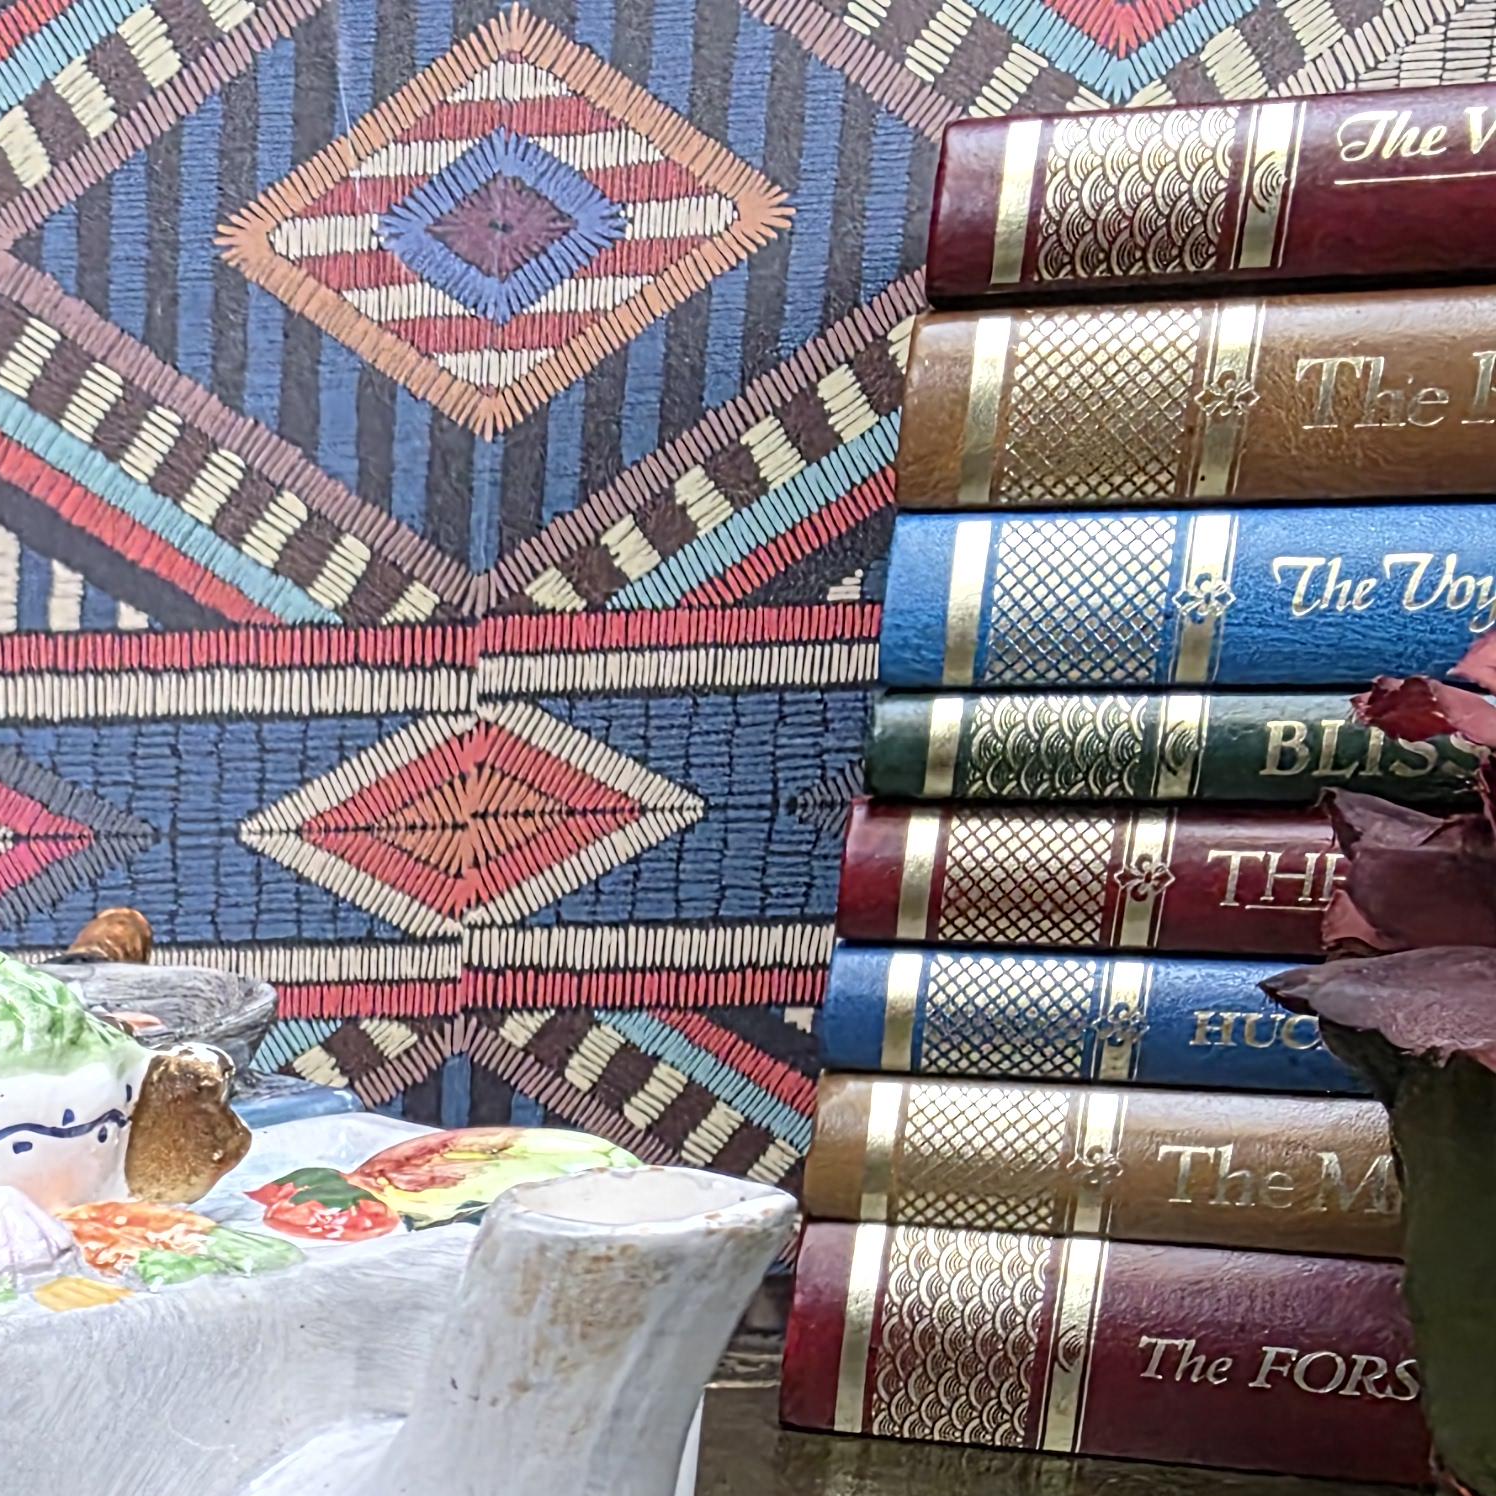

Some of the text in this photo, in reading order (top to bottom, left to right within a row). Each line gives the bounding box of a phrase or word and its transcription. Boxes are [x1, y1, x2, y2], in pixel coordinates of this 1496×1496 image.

[1336, 109, 1447, 162] The
[1295, 355, 1449, 430] The
[1272, 556, 1376, 617] The
[1157, 1142, 1294, 1209] The
[1137, 1335, 1422, 1401] The FORS
